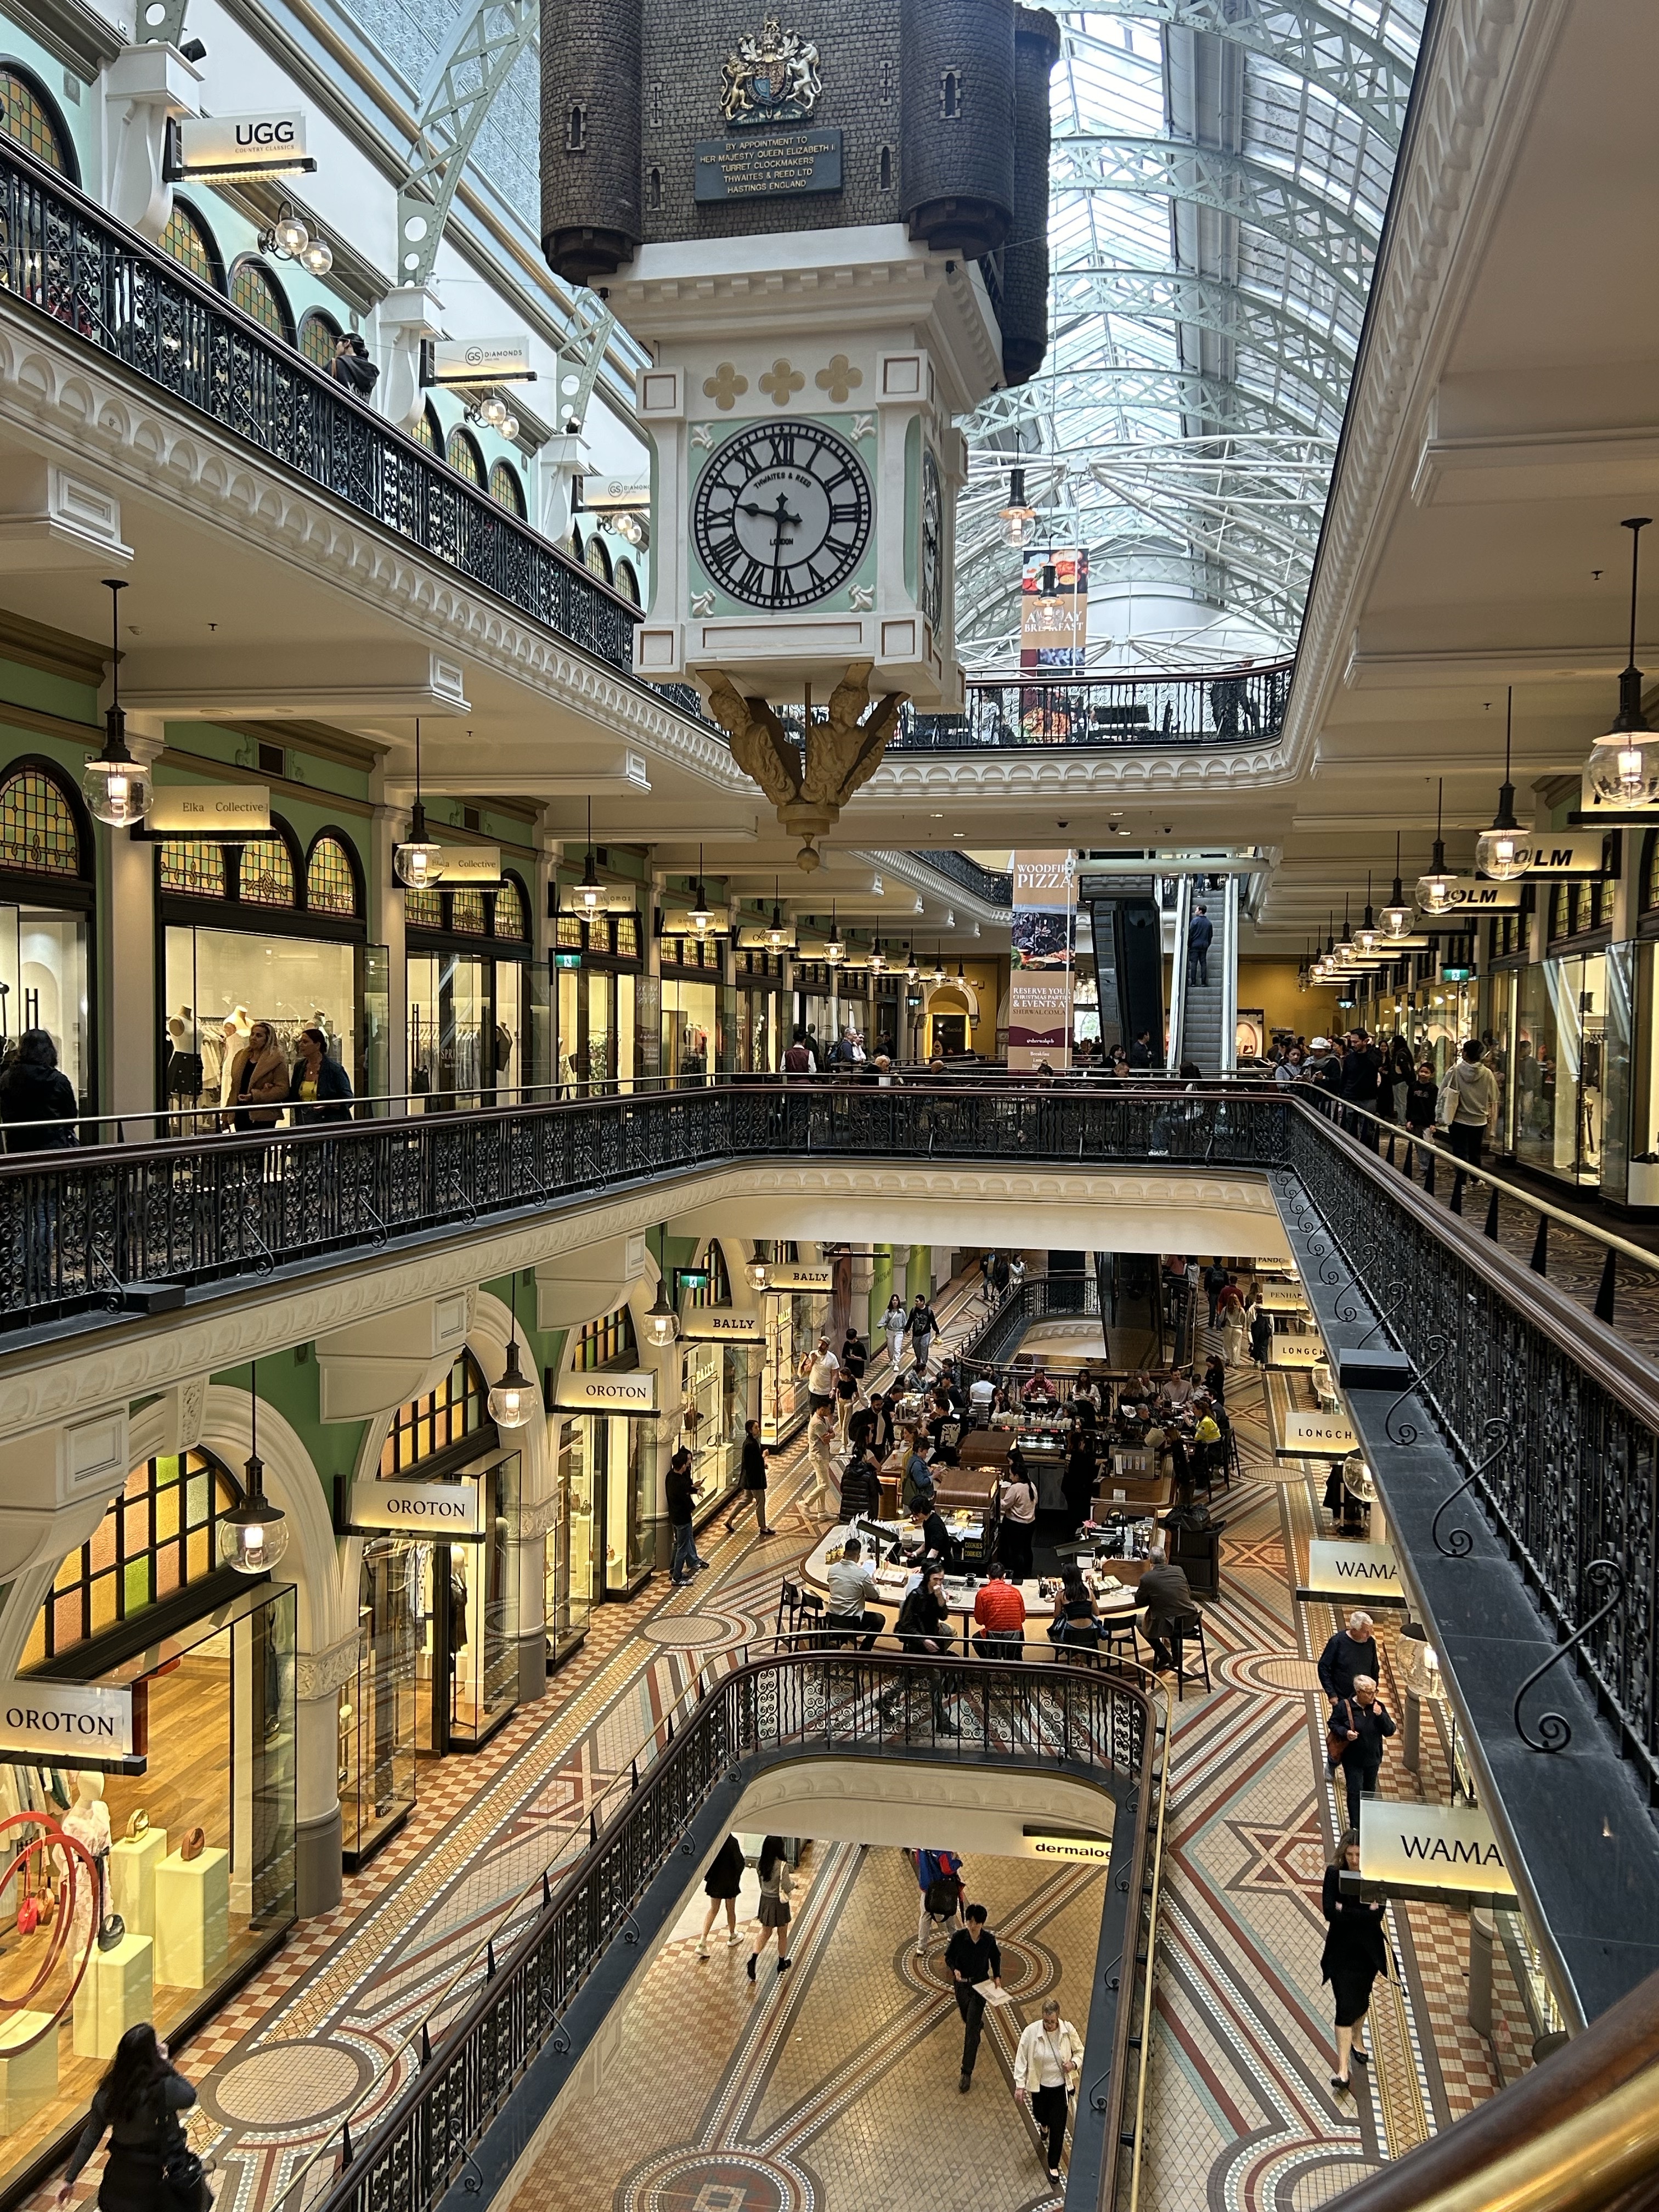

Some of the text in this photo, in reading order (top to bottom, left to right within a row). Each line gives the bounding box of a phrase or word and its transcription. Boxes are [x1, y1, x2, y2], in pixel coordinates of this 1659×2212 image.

[235, 121, 295, 145] UGG
[726, 143, 736, 151] BY
[740, 139, 793, 150] APPOINTMENT
[700, 155, 716, 163] HER
[719, 152, 755, 162] MAJESTY
[758, 149, 784, 158] QUEEN
[787, 145, 829, 155] ELIZABETH
[721, 157, 814, 172] TURRET CLOCKMAKERS
[724, 173, 764, 183] THWAITES
[774, 170, 795, 178] REED
[798, 168, 812, 176] LTD
[727, 180, 806, 194] HASTINGS ENGLAND
[467, 352, 481, 361] GS
[484, 349, 522, 358] DIAMONDS
[769, 435, 794, 465] XII
[753, 472, 786, 489] THWAITES
[795, 474, 811, 488] REED
[610, 485, 620, 493] GS
[1057, 611, 1082, 622] AY
[183, 802, 263, 812] Elka Collective
[1495, 849, 1573, 866] OLM
[1018, 873, 1074, 888] PIZZA
[793, 1273, 828, 1281] BALLY
[713, 1319, 755, 1329] BALLY
[586, 1385, 646, 1398] OROTON
[387, 1499, 465, 1517] OROTON
[6, 1708, 114, 1736] OROTON
[1400, 1835, 1504, 1867] WAMA
